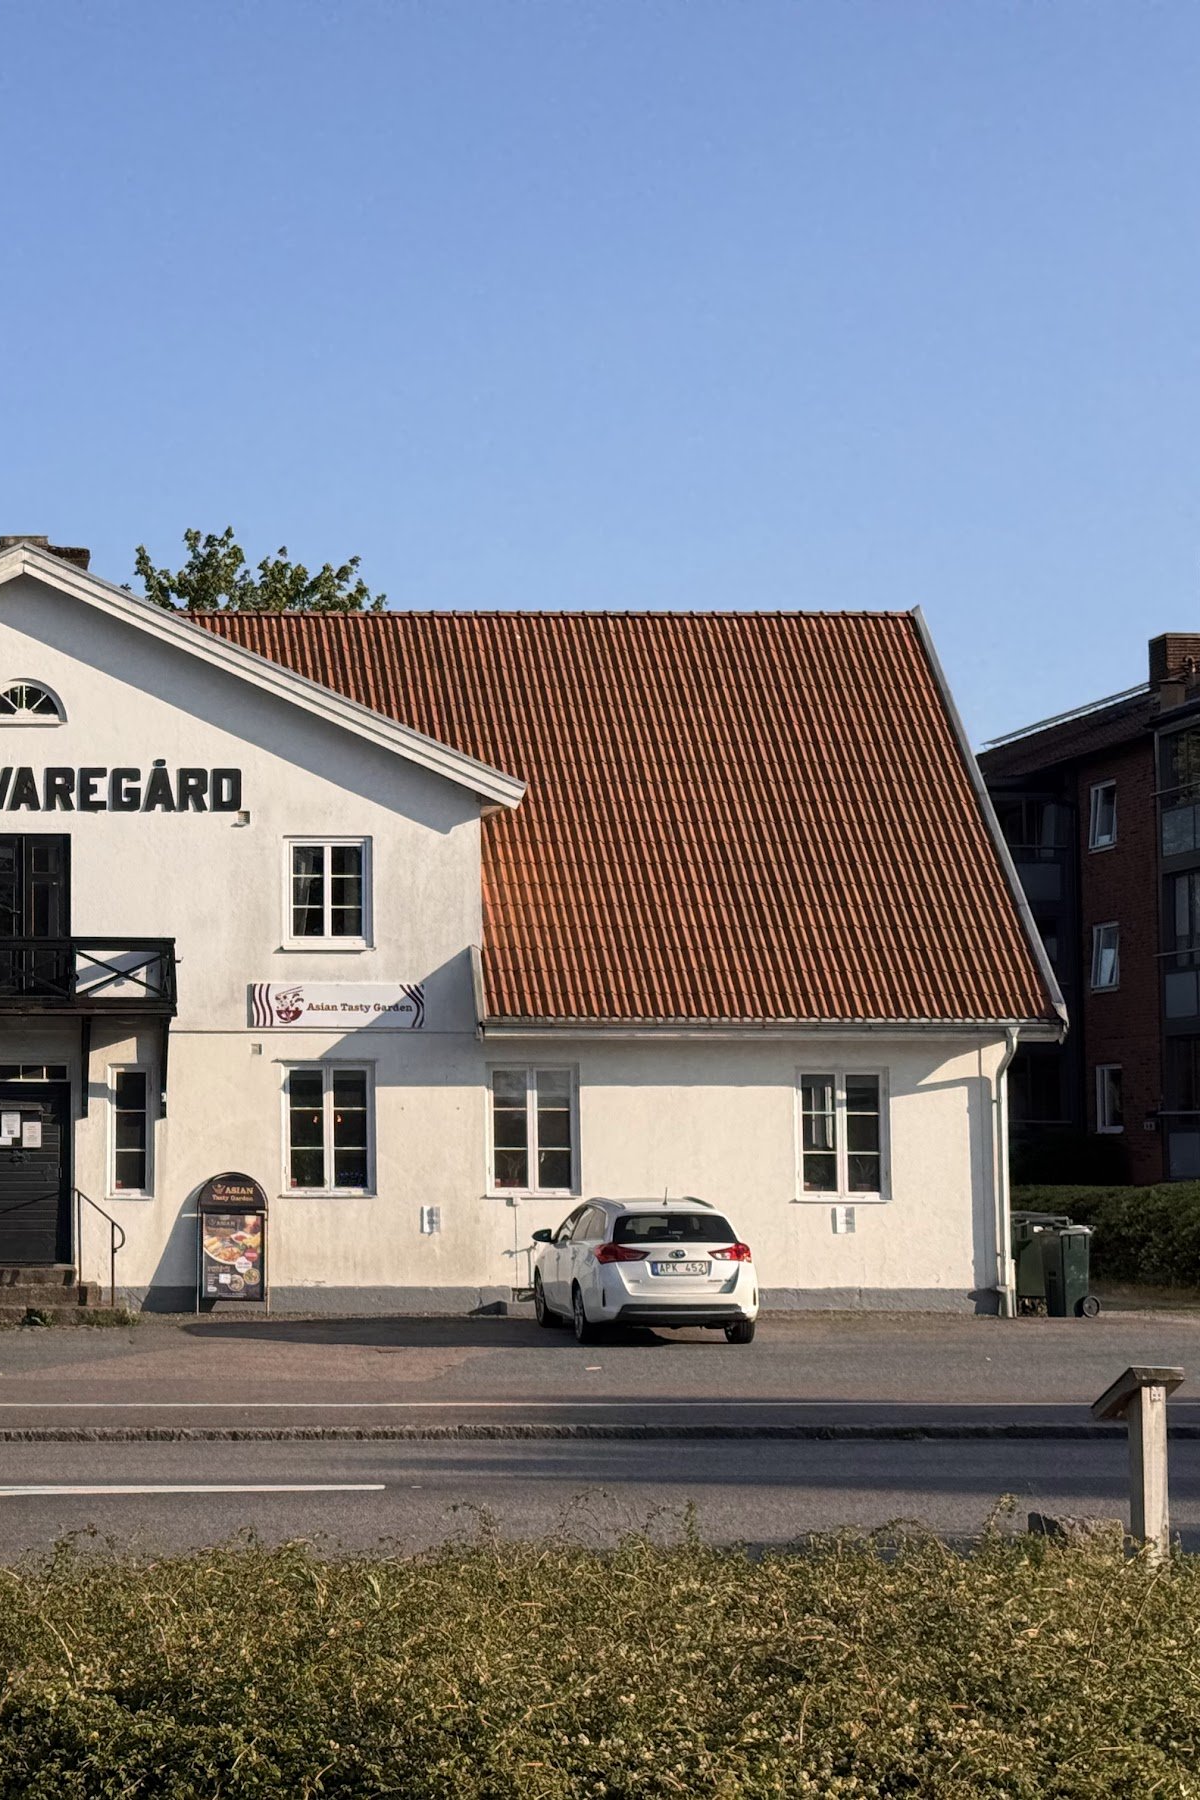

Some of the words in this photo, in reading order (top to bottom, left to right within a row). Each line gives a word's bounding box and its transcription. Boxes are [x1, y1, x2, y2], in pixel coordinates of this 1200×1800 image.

[307, 1003, 338, 1011] Asian
[341, 1003, 370, 1012] Tasty
[374, 1003, 413, 1012] Garden
[225, 1186, 253, 1195] ASIAN
[660, 1263, 677, 1272] APK
[685, 1263, 704, 1272] 452
